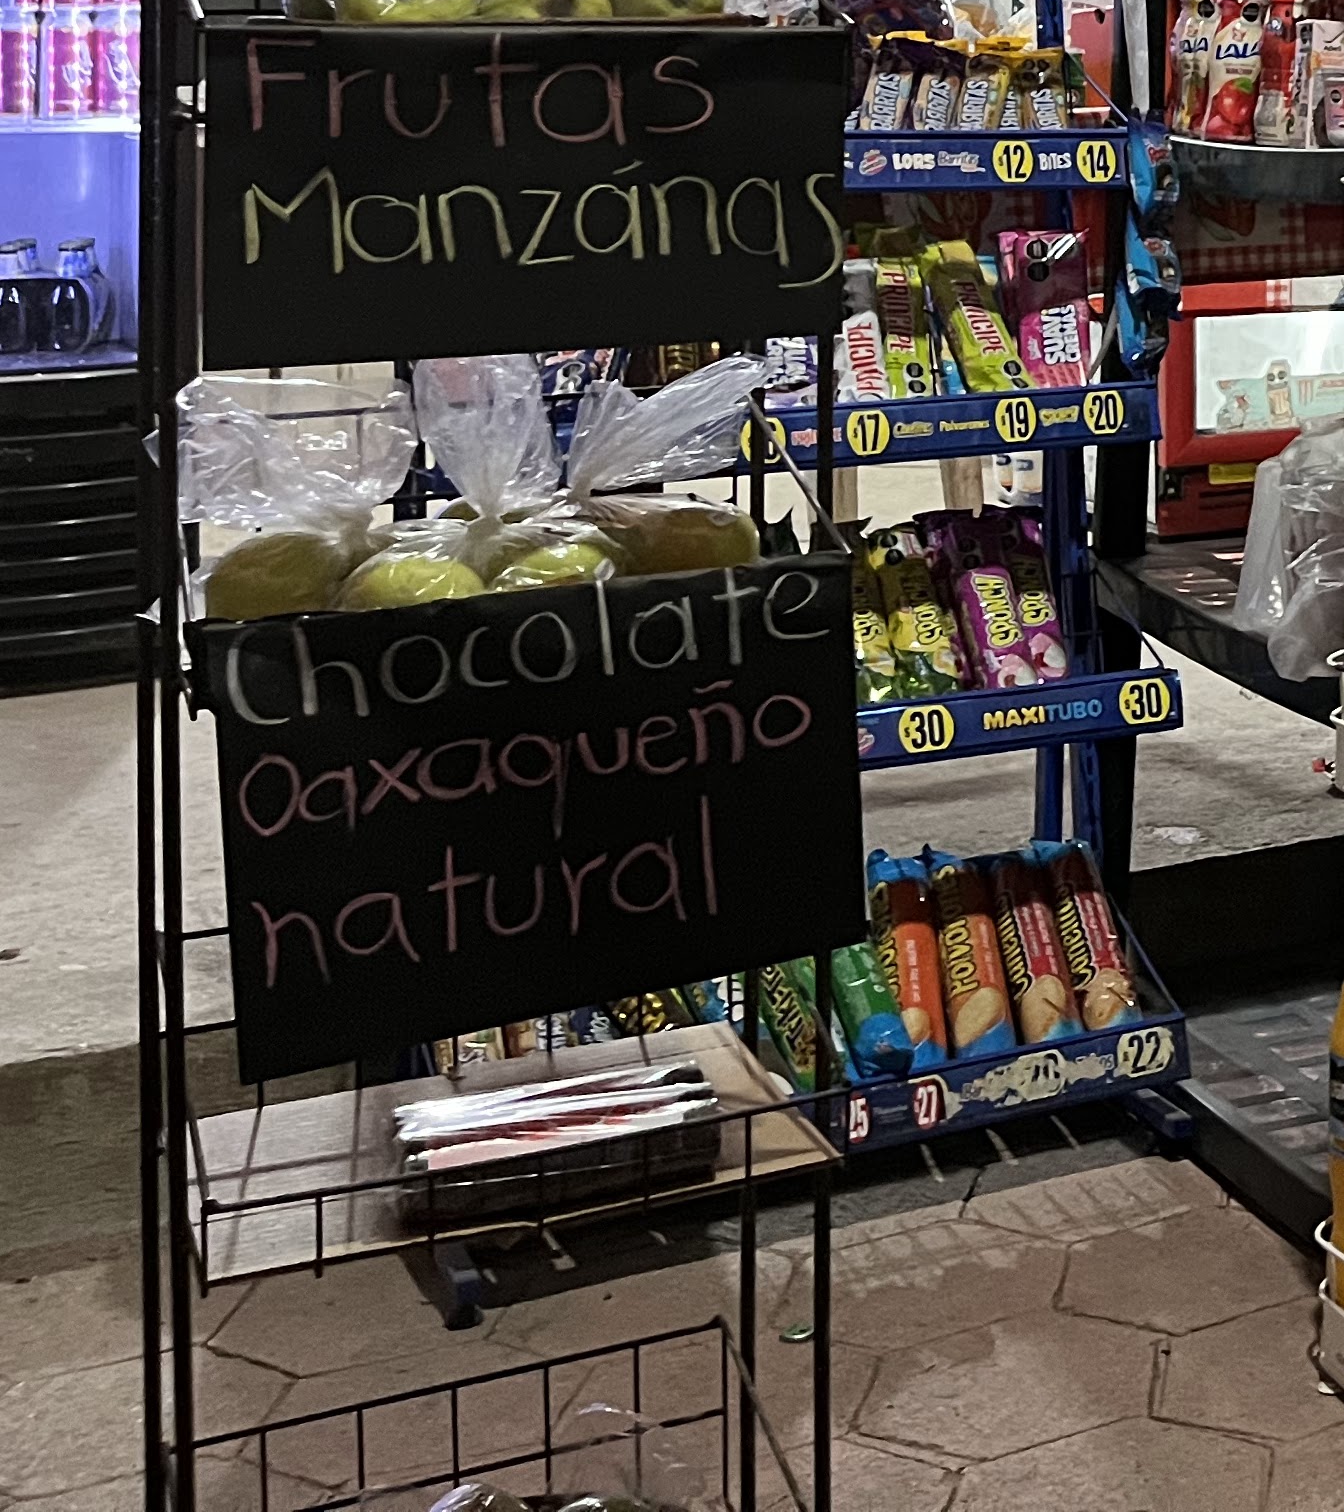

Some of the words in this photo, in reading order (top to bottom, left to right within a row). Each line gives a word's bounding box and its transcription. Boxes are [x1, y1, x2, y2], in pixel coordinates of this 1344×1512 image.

[244, 32, 716, 149] Frutas
[998, 144, 1028, 179] $12
[1081, 144, 1110, 179] $14
[851, 414, 883, 454] $17
[999, 402, 1031, 440] $19
[1088, 393, 1121, 431] $20
[226, 565, 830, 726] Chocolate
[238, 679, 810, 838] Oaxaqueño
[904, 708, 947, 750] $30
[983, 698, 1103, 731] MAXITUBO
[1124, 680, 1165, 721] $30
[250, 796, 718, 988] natural
